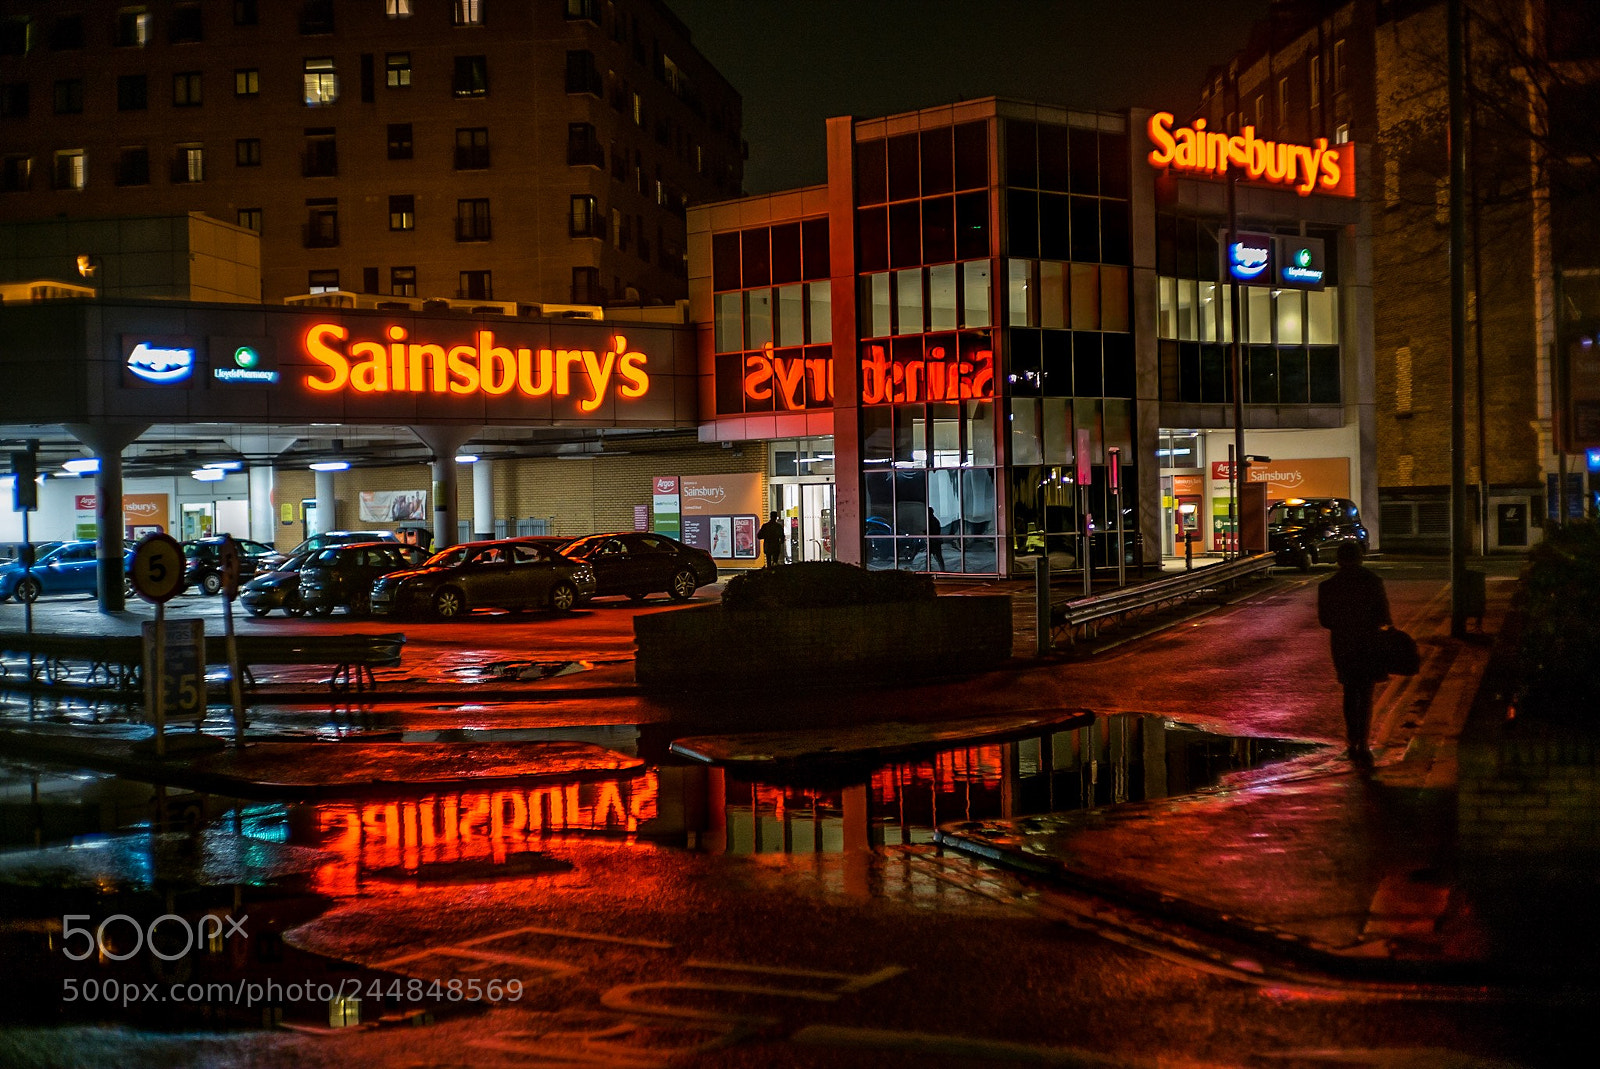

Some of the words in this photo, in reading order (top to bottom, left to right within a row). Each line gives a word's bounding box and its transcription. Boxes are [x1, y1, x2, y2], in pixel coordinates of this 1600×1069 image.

[1150, 111, 1341, 193] Sainsbury's
[305, 323, 649, 411] Sainsbury's
[213, 368, 274, 381] LloydsPharmacy
[1251, 470, 1302, 483] Sainsbury's
[657, 478, 675, 489] Argos
[684, 485, 724, 498] Sainsbury's
[149, 554, 167, 582] 5
